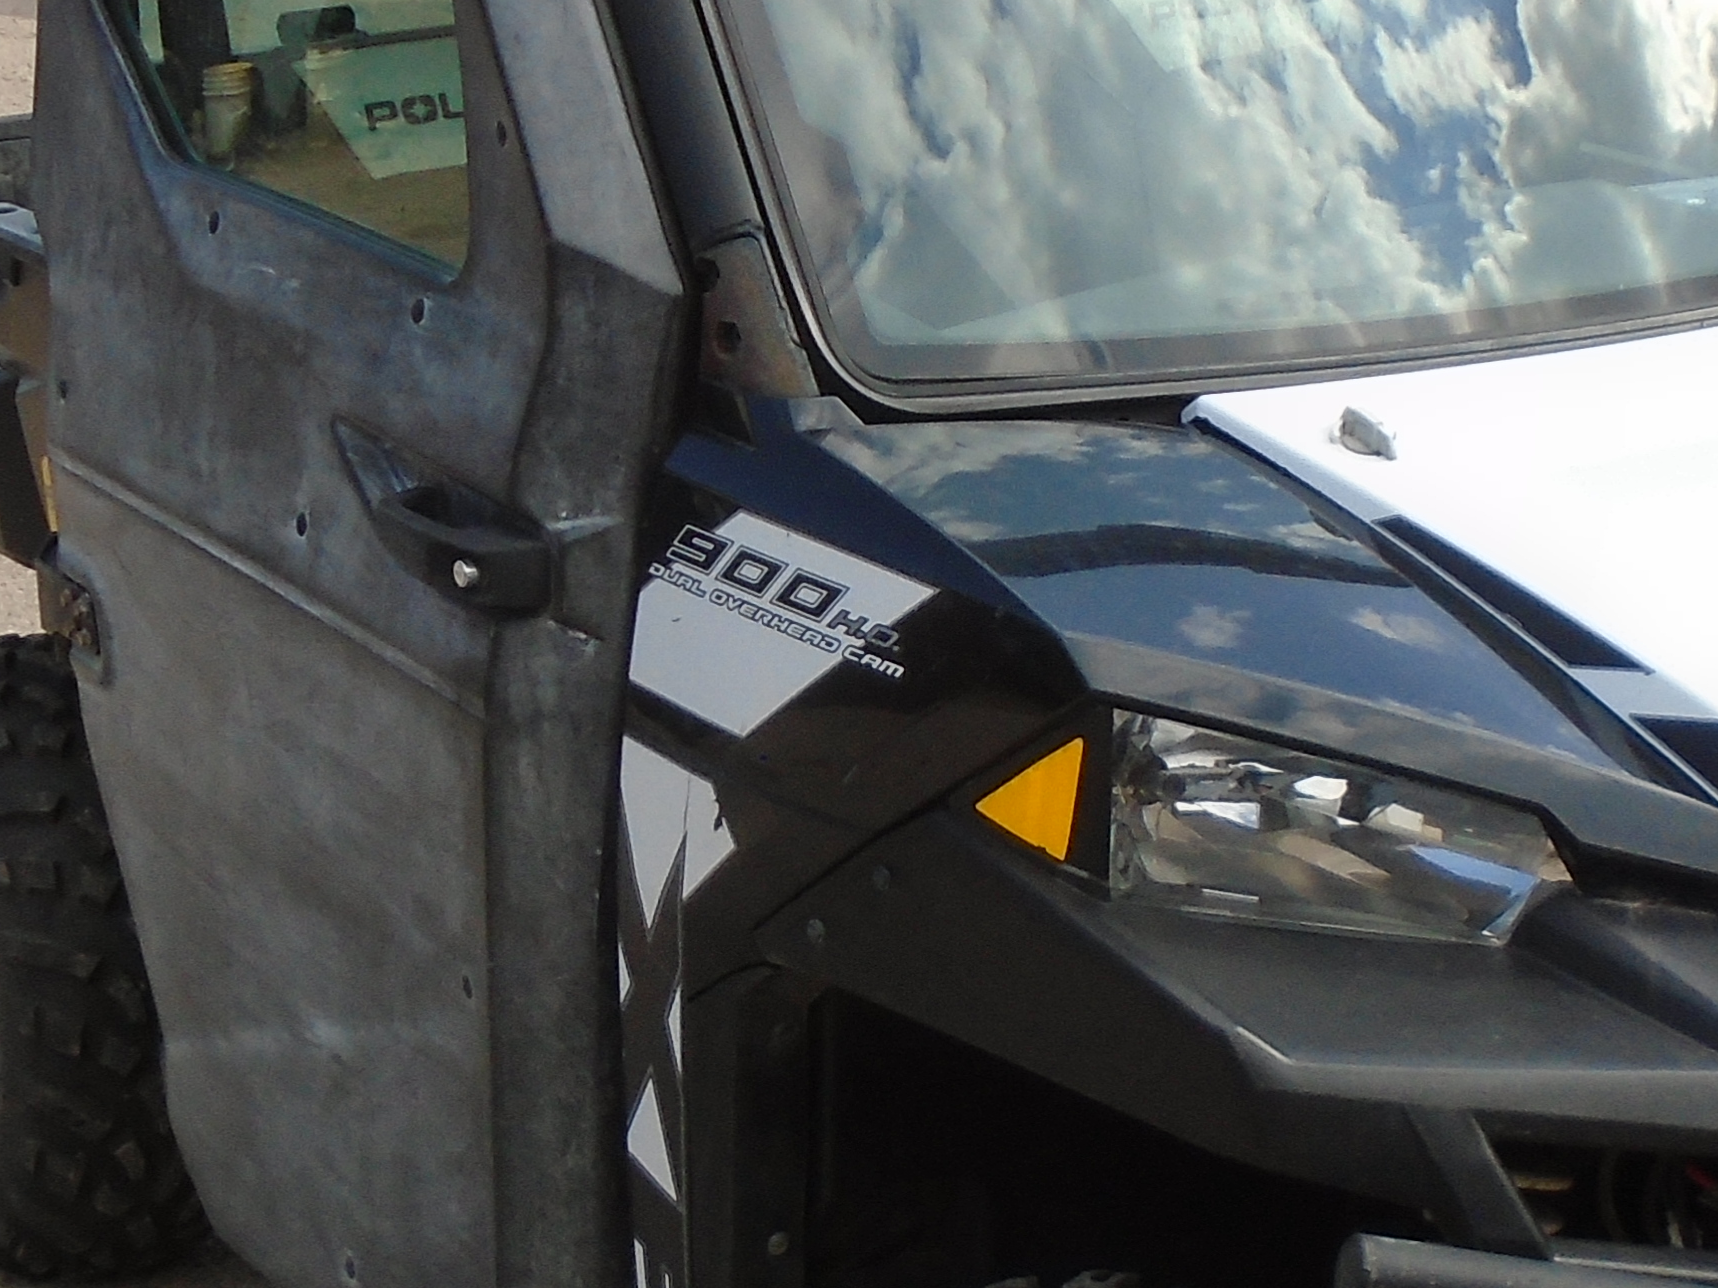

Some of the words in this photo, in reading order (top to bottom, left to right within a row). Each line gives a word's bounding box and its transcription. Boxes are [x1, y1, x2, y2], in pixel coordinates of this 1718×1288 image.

[648, 562, 707, 598] DUAL
[709, 587, 841, 653] OVERHEAD
[841, 643, 905, 679] CAM
[666, 524, 850, 624] 900
[826, 609, 902, 652] H.O.
